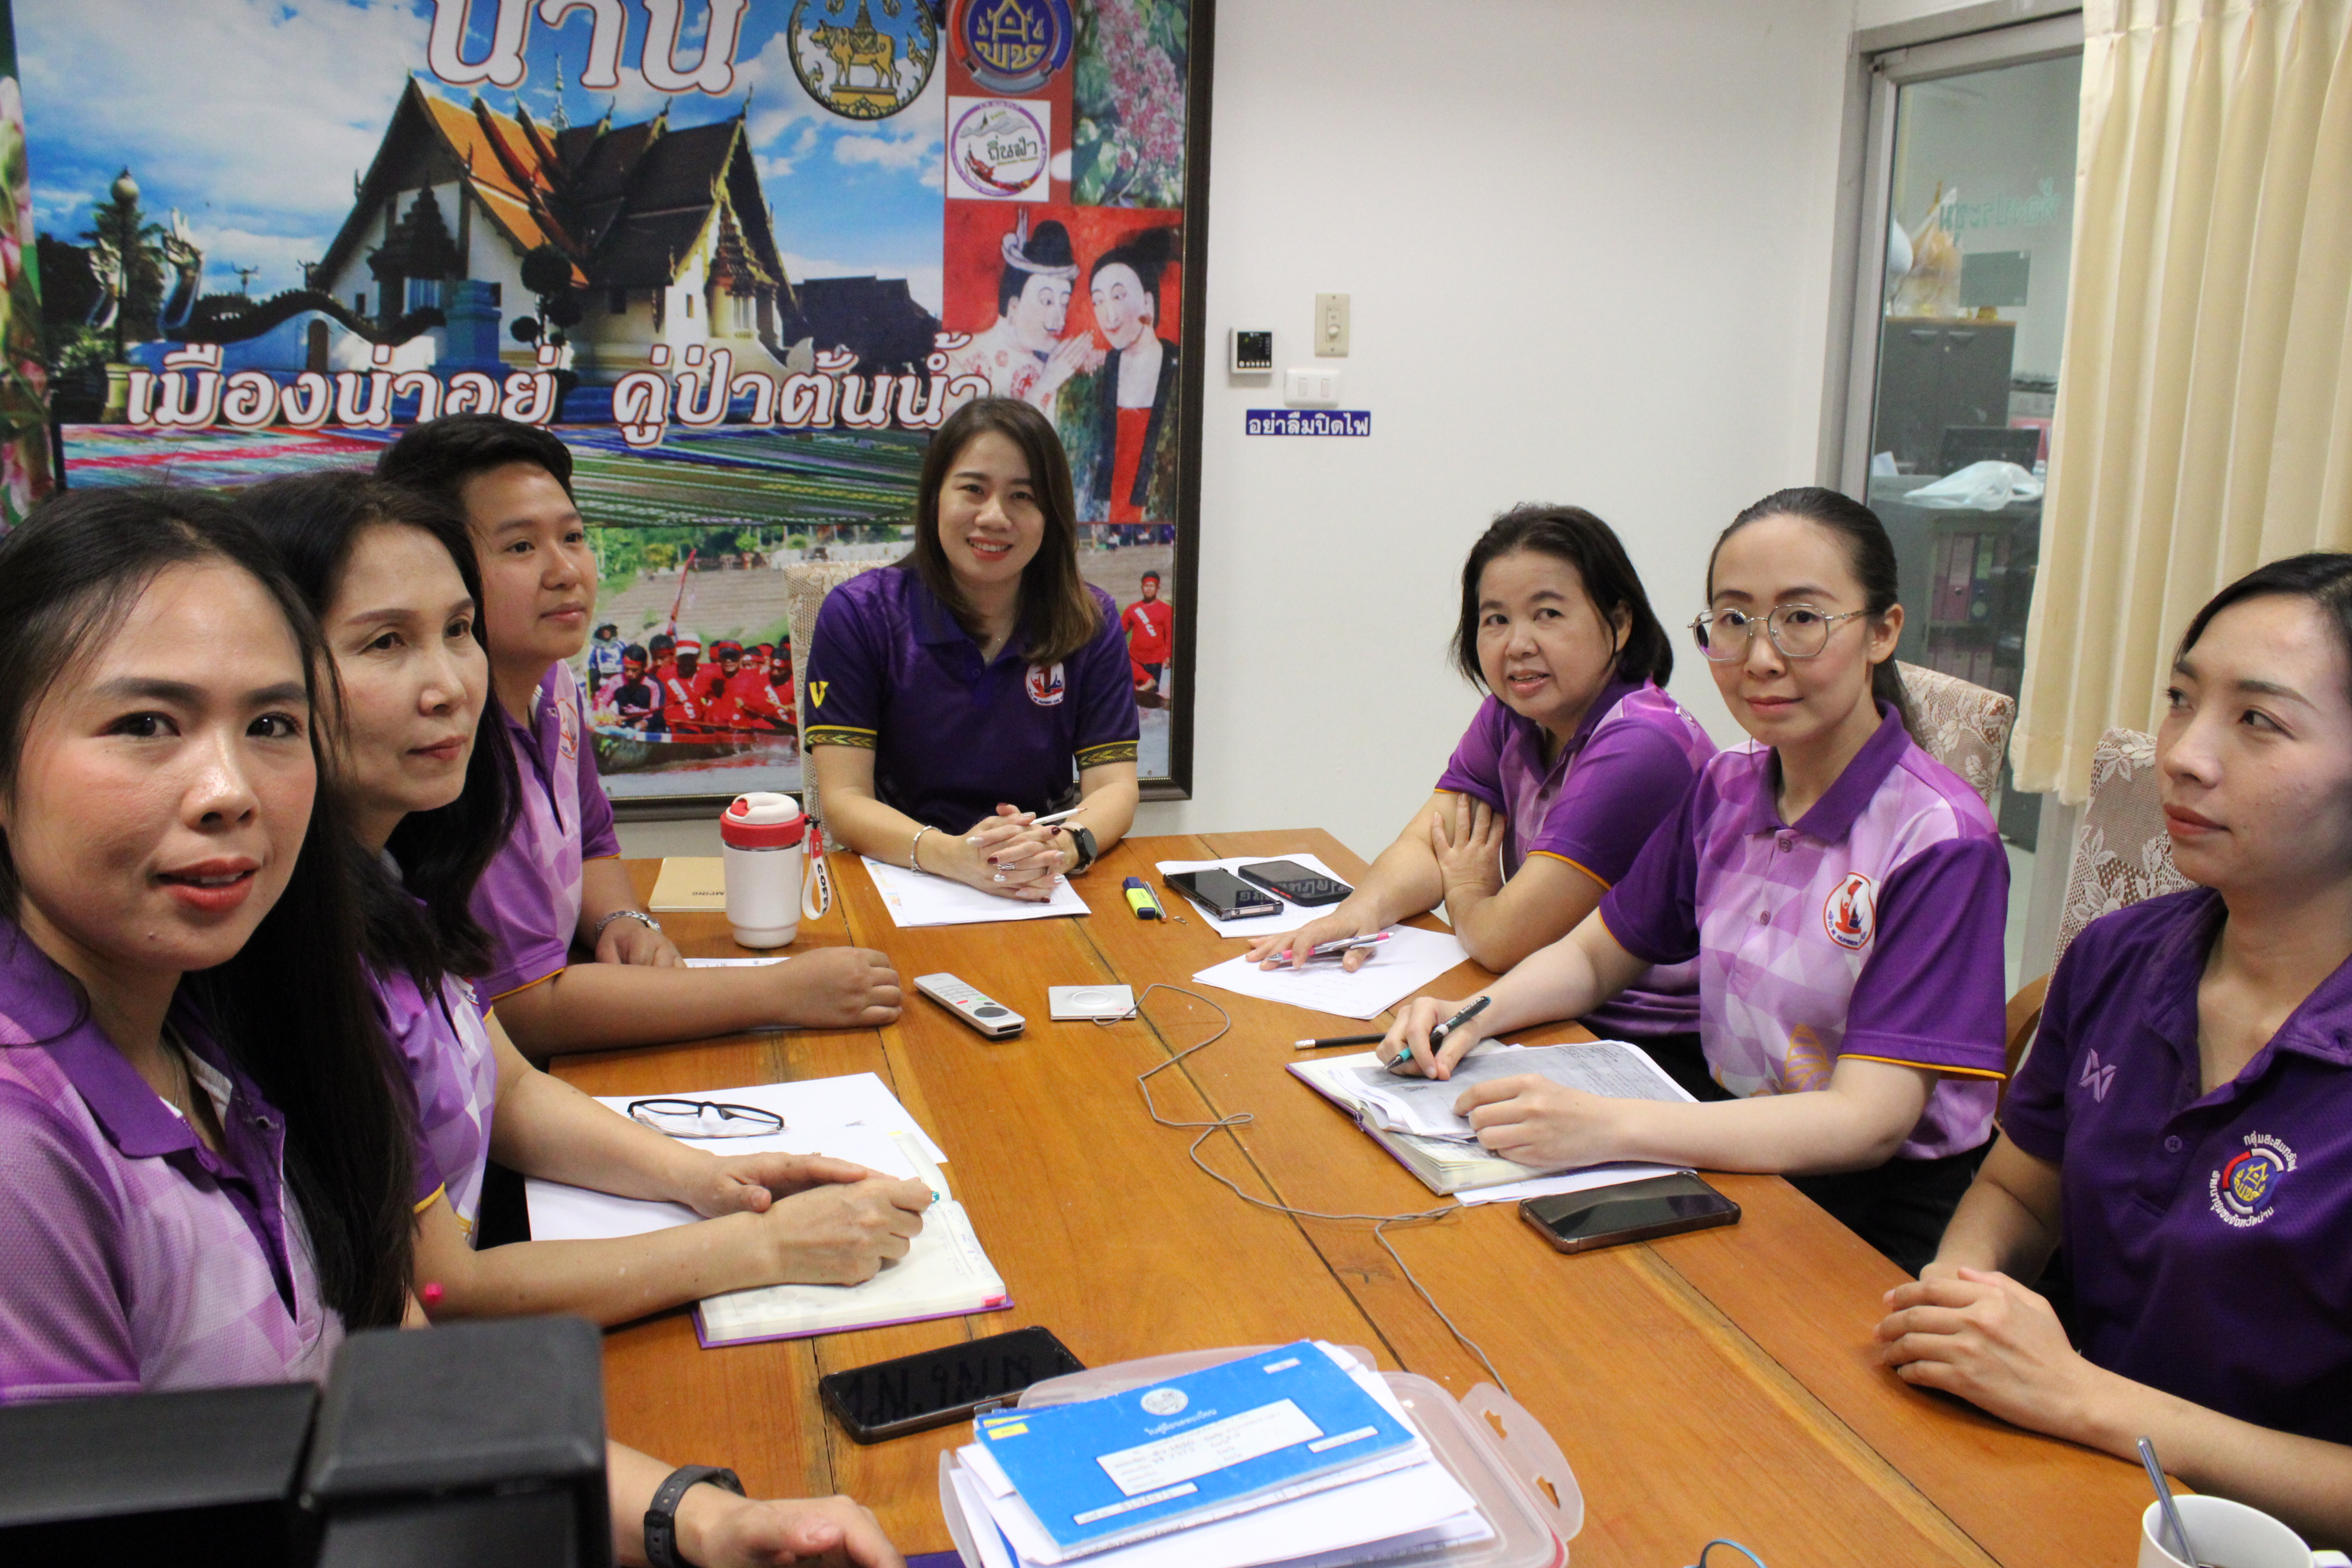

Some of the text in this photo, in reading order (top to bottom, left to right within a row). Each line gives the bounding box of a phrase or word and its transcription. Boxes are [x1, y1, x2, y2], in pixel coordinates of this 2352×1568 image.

[127, 344, 557, 431] เมืองน่าอย่
[1249, 411, 1368, 435] อย่าลืมปิดไฟ
